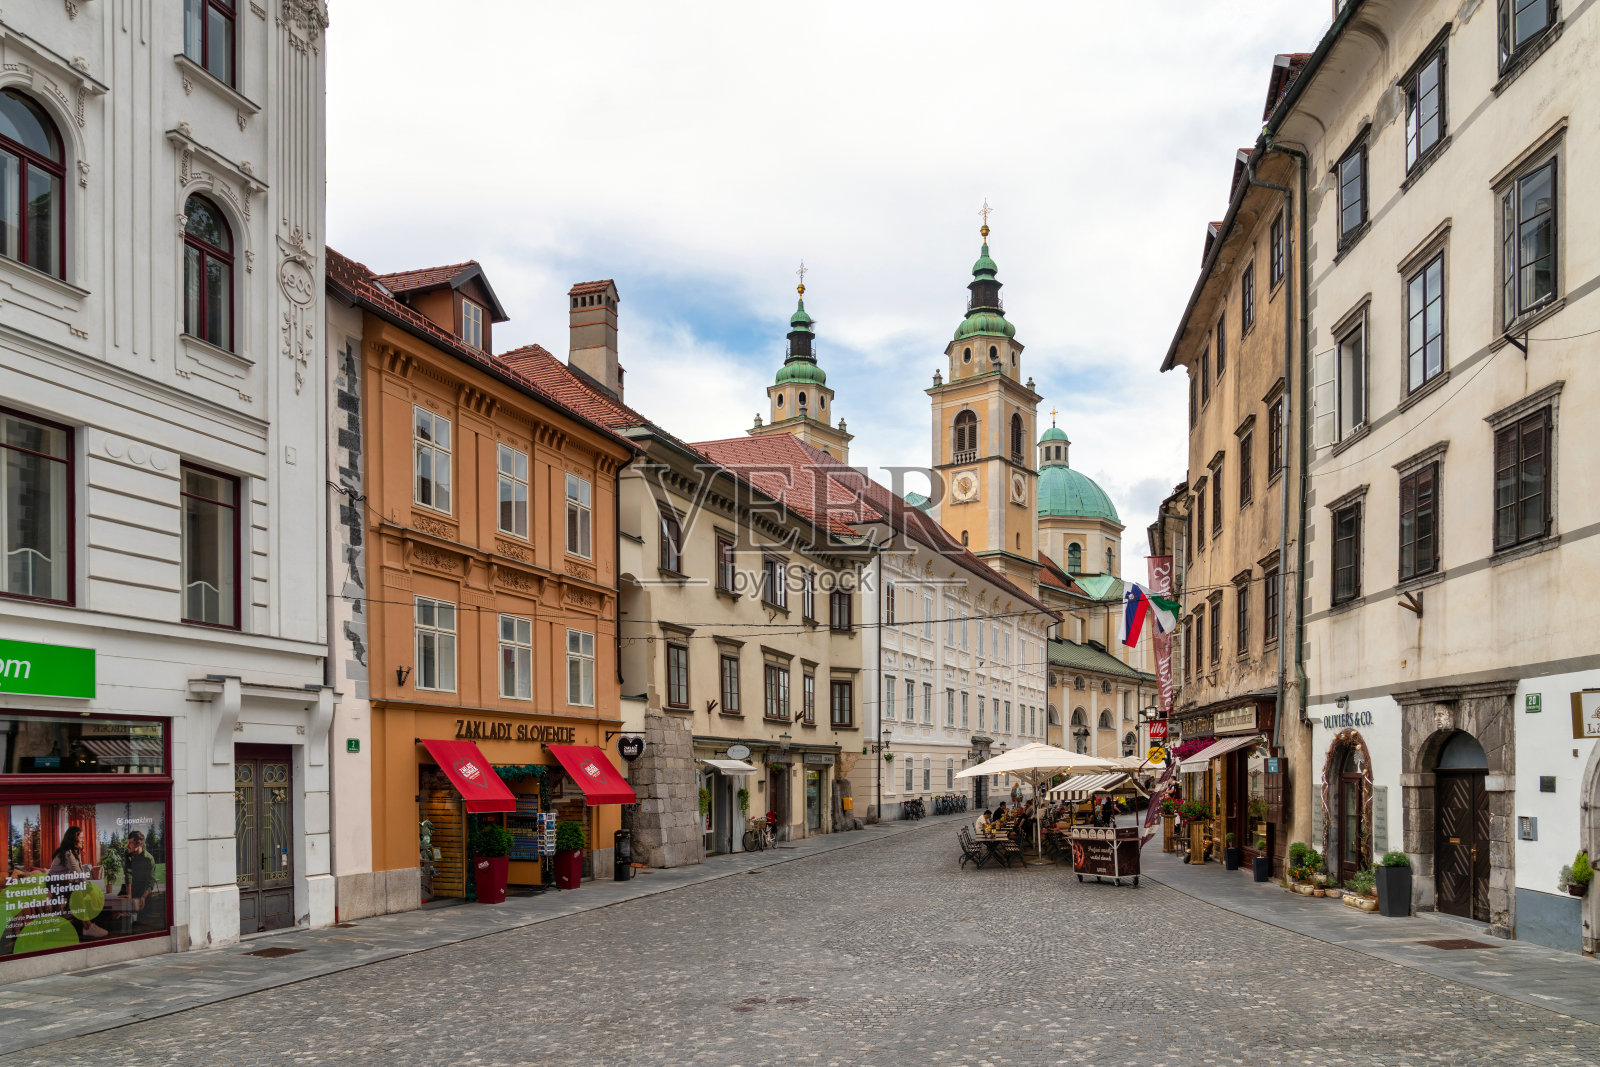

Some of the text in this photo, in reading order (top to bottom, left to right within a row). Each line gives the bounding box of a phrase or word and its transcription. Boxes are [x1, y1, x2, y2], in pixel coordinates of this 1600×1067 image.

[1528, 695, 1537, 705] 20
[1323, 710, 1374, 729] OLIVIERS & CO.
[456, 719, 576, 743] ZAKLADI SLOVENIJE
[1150, 722, 1167, 736] illy
[1586, 723, 1600, 735] L
[5, 870, 91, 886] Za vse pomembne
[5, 881, 87, 898] trenutke kjerkoli
[5, 895, 68, 911] in kadarkoli.
